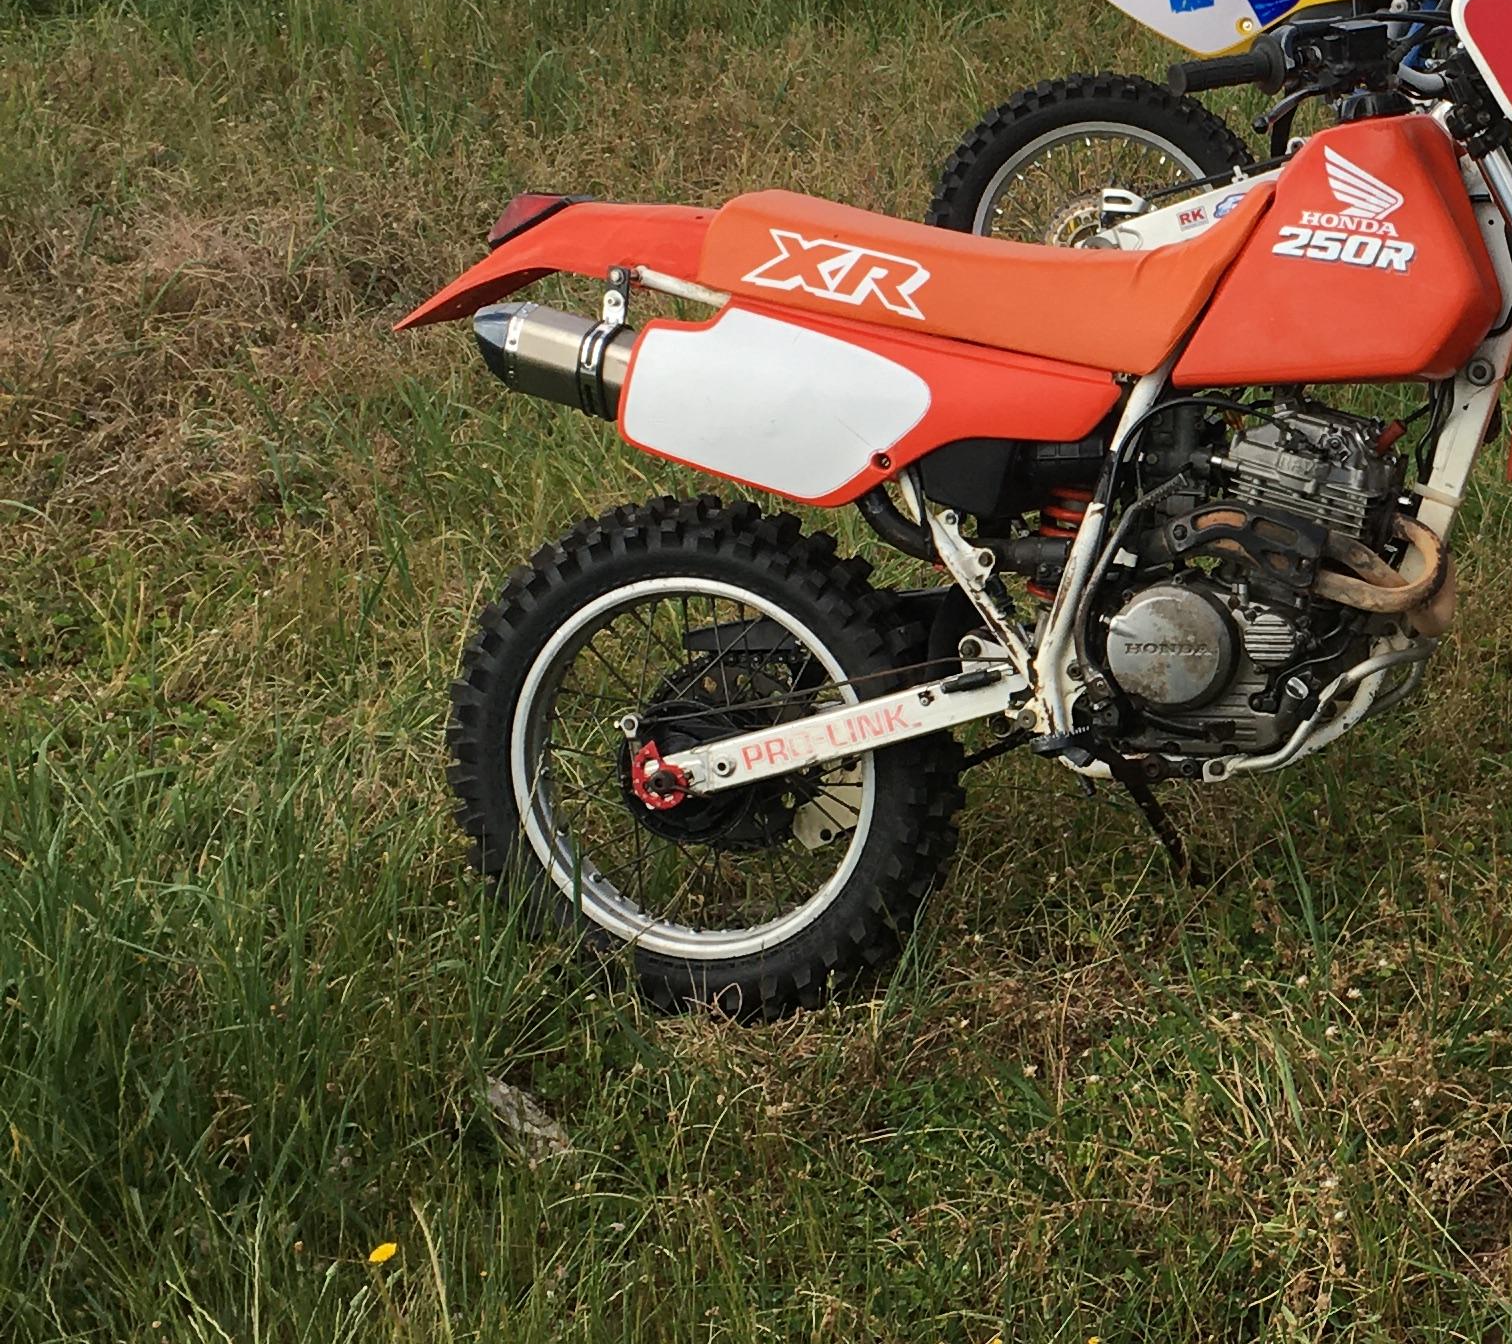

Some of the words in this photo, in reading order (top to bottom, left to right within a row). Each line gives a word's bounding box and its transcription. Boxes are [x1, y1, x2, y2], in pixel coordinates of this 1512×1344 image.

[1179, 208, 1205, 225] RK
[1298, 210, 1400, 238] HONDA
[1271, 224, 1417, 273] 250R
[740, 227, 932, 321] XR
[1123, 641, 1217, 657] HONDA
